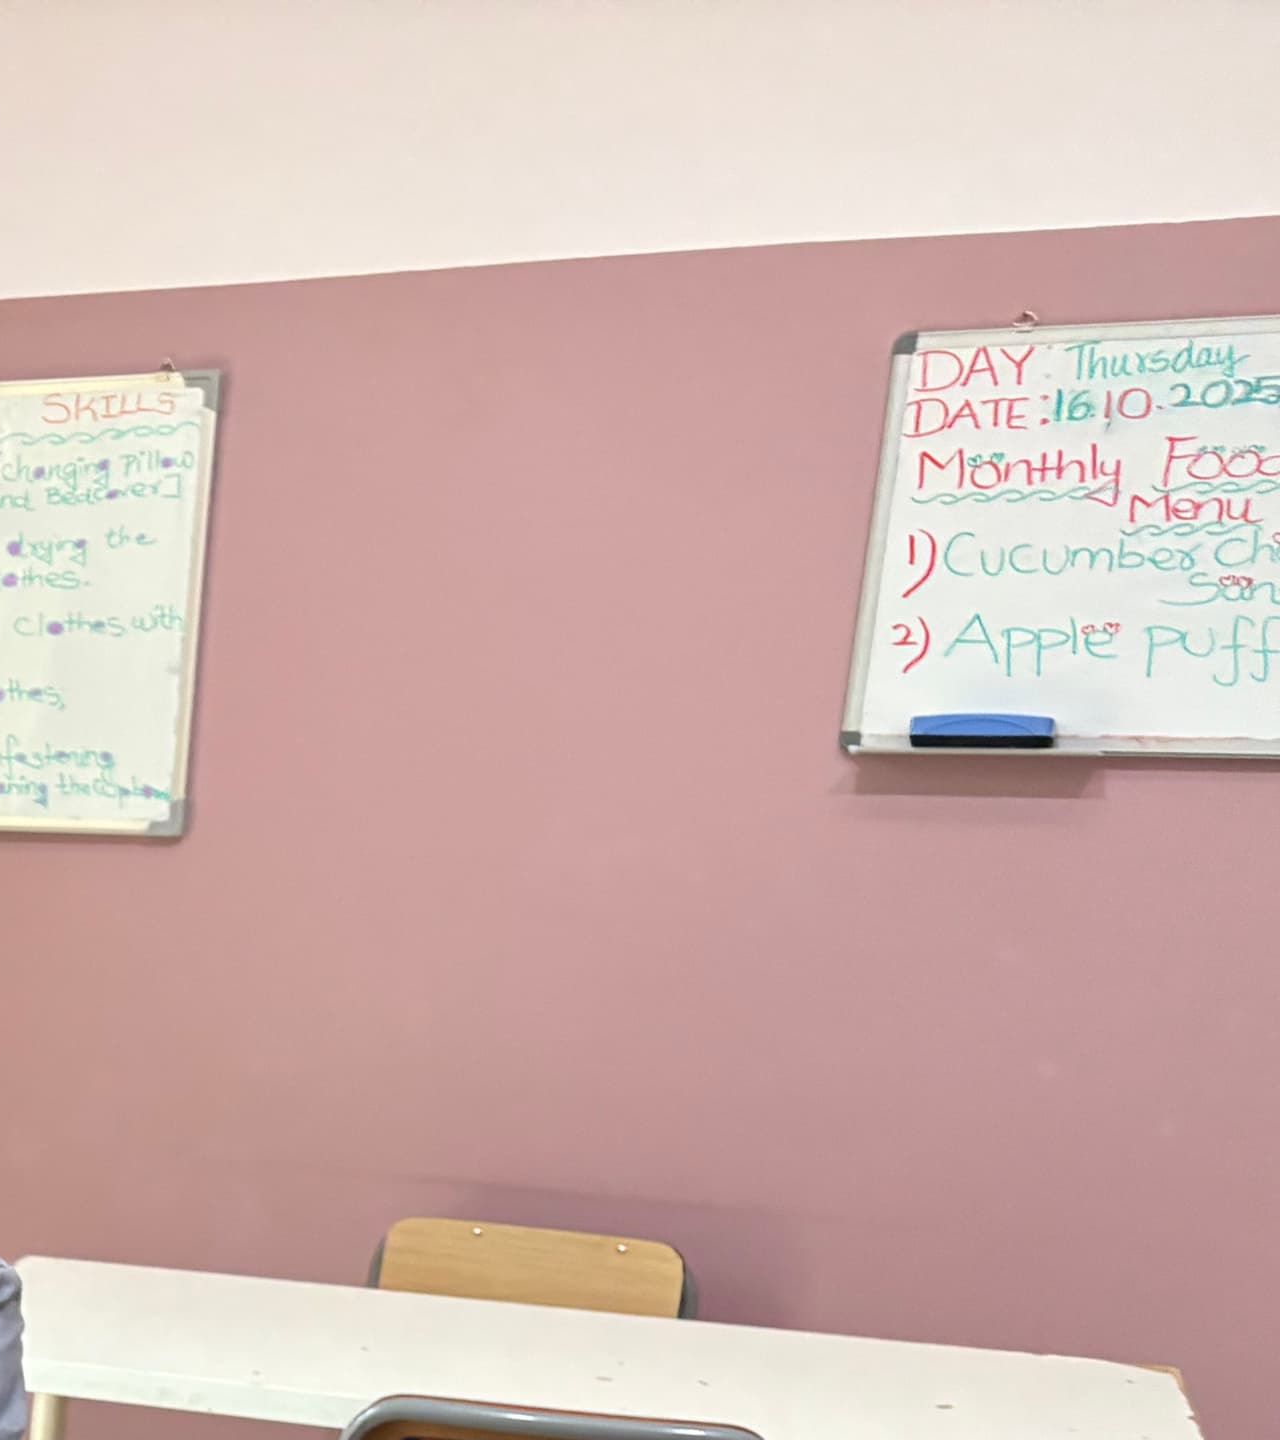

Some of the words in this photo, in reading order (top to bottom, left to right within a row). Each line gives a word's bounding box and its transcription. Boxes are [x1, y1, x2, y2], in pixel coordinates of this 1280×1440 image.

[1064, 339, 1251, 379] Thursday
[42, 391, 178, 423] SKILLS
[917, 443, 1122, 507] Monthly
[1129, 494, 1264, 524] Menu
[105, 524, 157, 548] the
[943, 532, 1202, 577] Cucumber
[131, 604, 184, 632] with
[892, 616, 932, 674] 2)
[944, 614, 1120, 677] Apple
